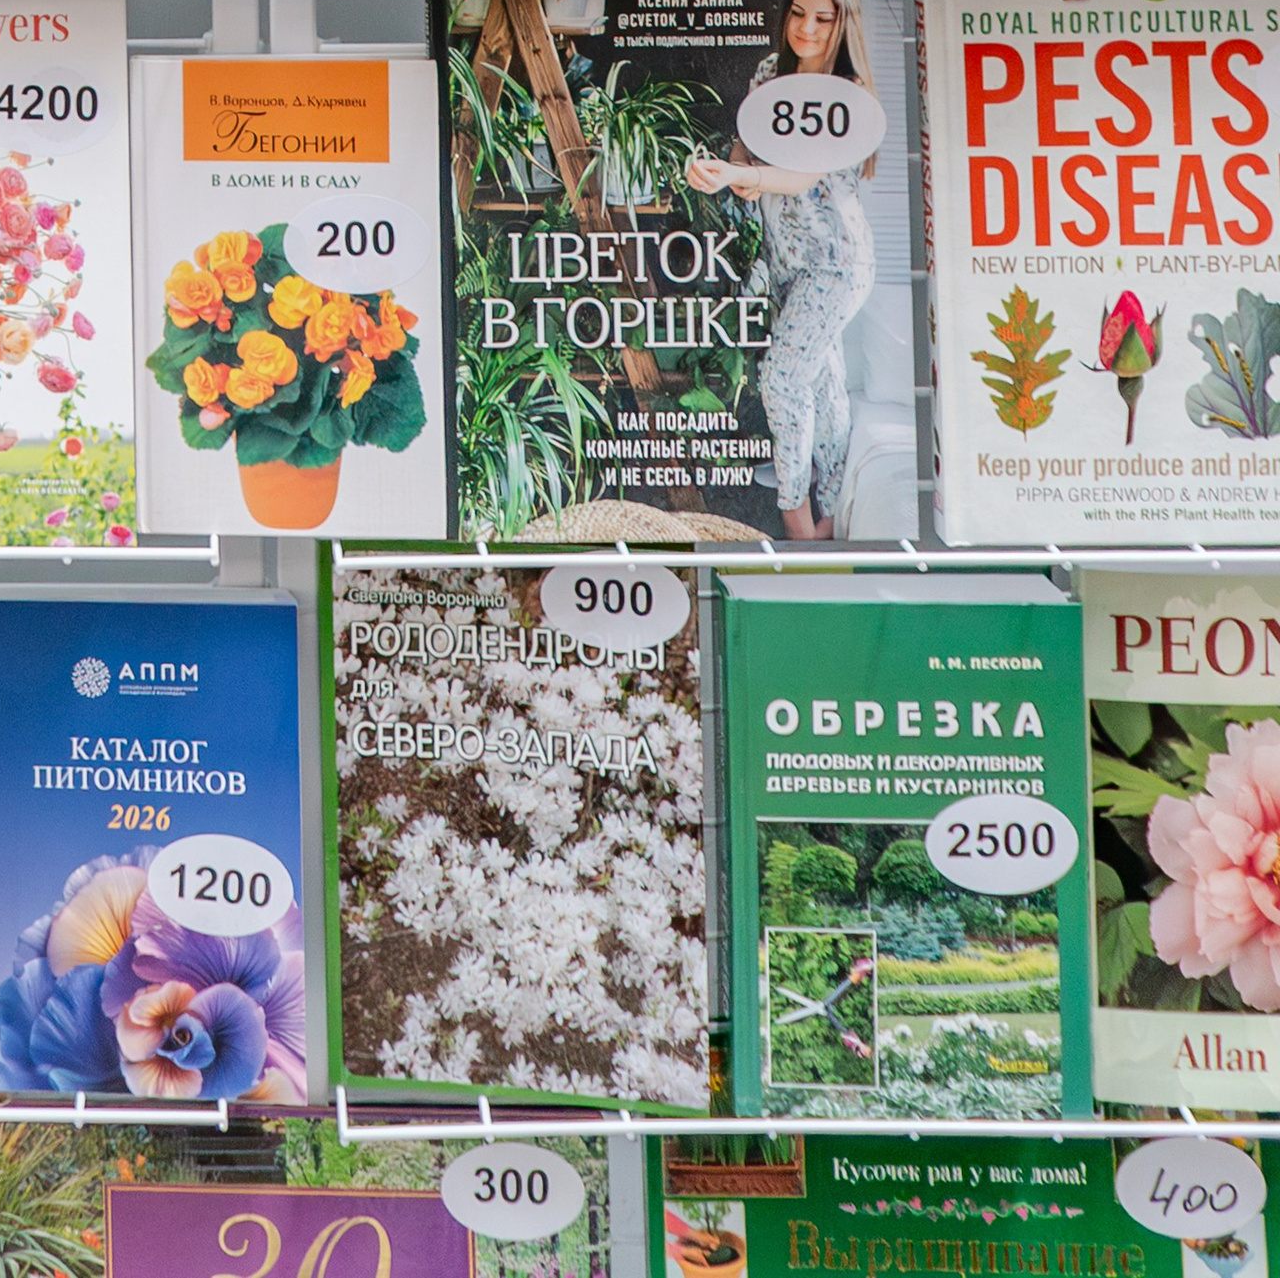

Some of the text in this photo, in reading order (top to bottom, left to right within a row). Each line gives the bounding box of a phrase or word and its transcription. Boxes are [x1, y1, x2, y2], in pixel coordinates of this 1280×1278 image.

[963, 39, 1269, 147] PESTS
[771, 102, 850, 139] 850
[317, 221, 396, 255] 200
[507, 232, 741, 284] ЦВЕТОК
[482, 298, 771, 348] В ГОРШКЕ
[617, 411, 738, 432] КАК ПОСАДИТЬ
[586, 439, 771, 459] КОМНАТНЫЕ РАСТЕНИЯ
[574, 578, 654, 615] 900
[119, 663, 198, 681] АППМ
[766, 699, 1044, 738] ОБРЕЗКА
[70, 736, 208, 763] КАТАЛОГ
[352, 722, 657, 778] СЕВЕРО-ЗАПАДА
[767, 753, 1045, 772] ПЛОДОВЫХ И ДЕКОРАТИВНЫХ
[33, 766, 246, 795] ПИТОМНИКОВ
[767, 775, 1045, 795] ДЕРЕВЬЕВ И КУСТАРНИКОВ
[107, 804, 171, 831] 2026
[946, 822, 1055, 859] 2500
[168, 863, 272, 907] 1200
[1174, 1036, 1267, 1072] Allan
[473, 1169, 550, 1205] 300
[832, 1157, 920, 1185] Кусочек
[990, 1161, 1023, 1183] вас
[1031, 1162, 1087, 1185] дома!
[1149, 1167, 1238, 1216] 400
